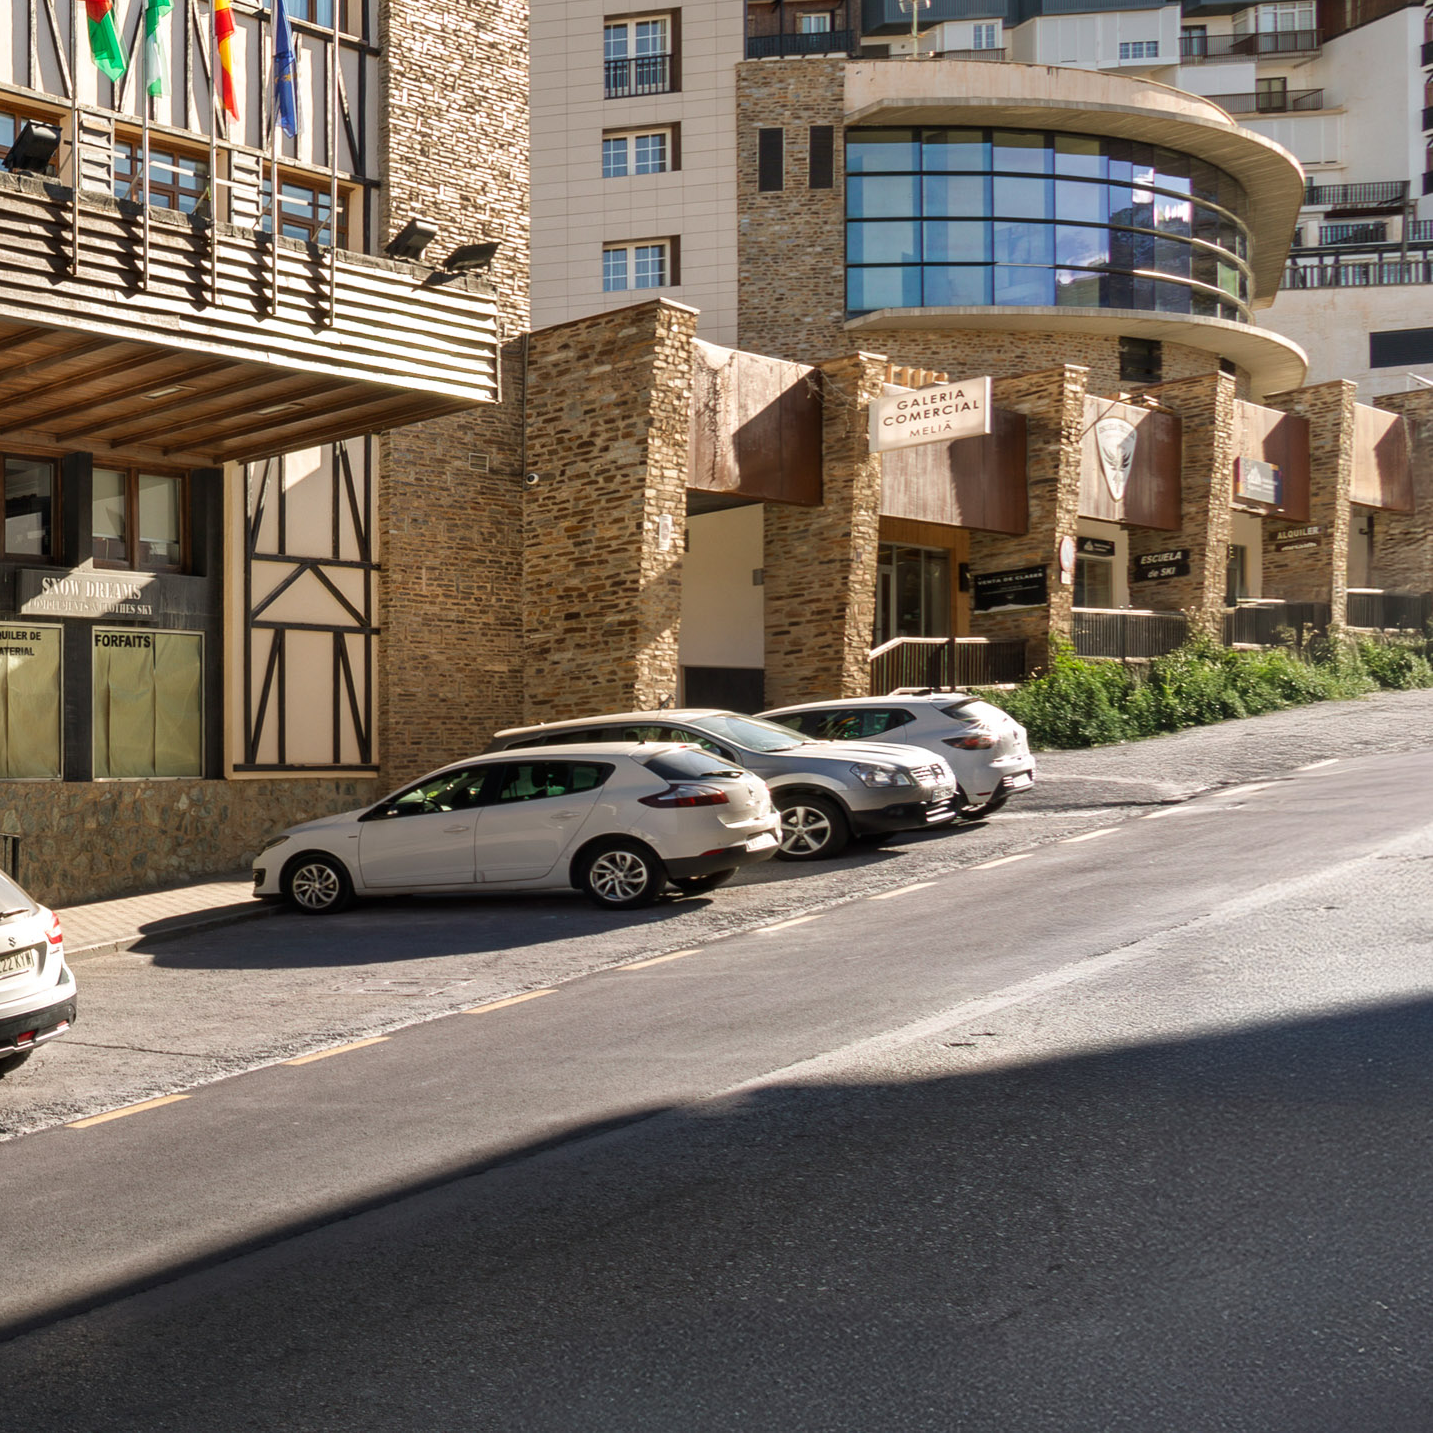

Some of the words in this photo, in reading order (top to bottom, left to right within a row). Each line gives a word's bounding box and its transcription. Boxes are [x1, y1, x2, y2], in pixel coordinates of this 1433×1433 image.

[896, 390, 965, 411] GALERIA
[883, 400, 980, 427] COMERCIAL
[1277, 526, 1319, 540] ALQUILER
[1140, 551, 1182, 565] ESCUELA
[1161, 567, 1176, 576] SKI
[42, 577, 81, 596] SNOW
[86, 581, 142, 600] DREAMS
[137, 604, 153, 616] SKY
[30, 631, 42, 640] DE
[95, 634, 151, 648] FORFAITS
